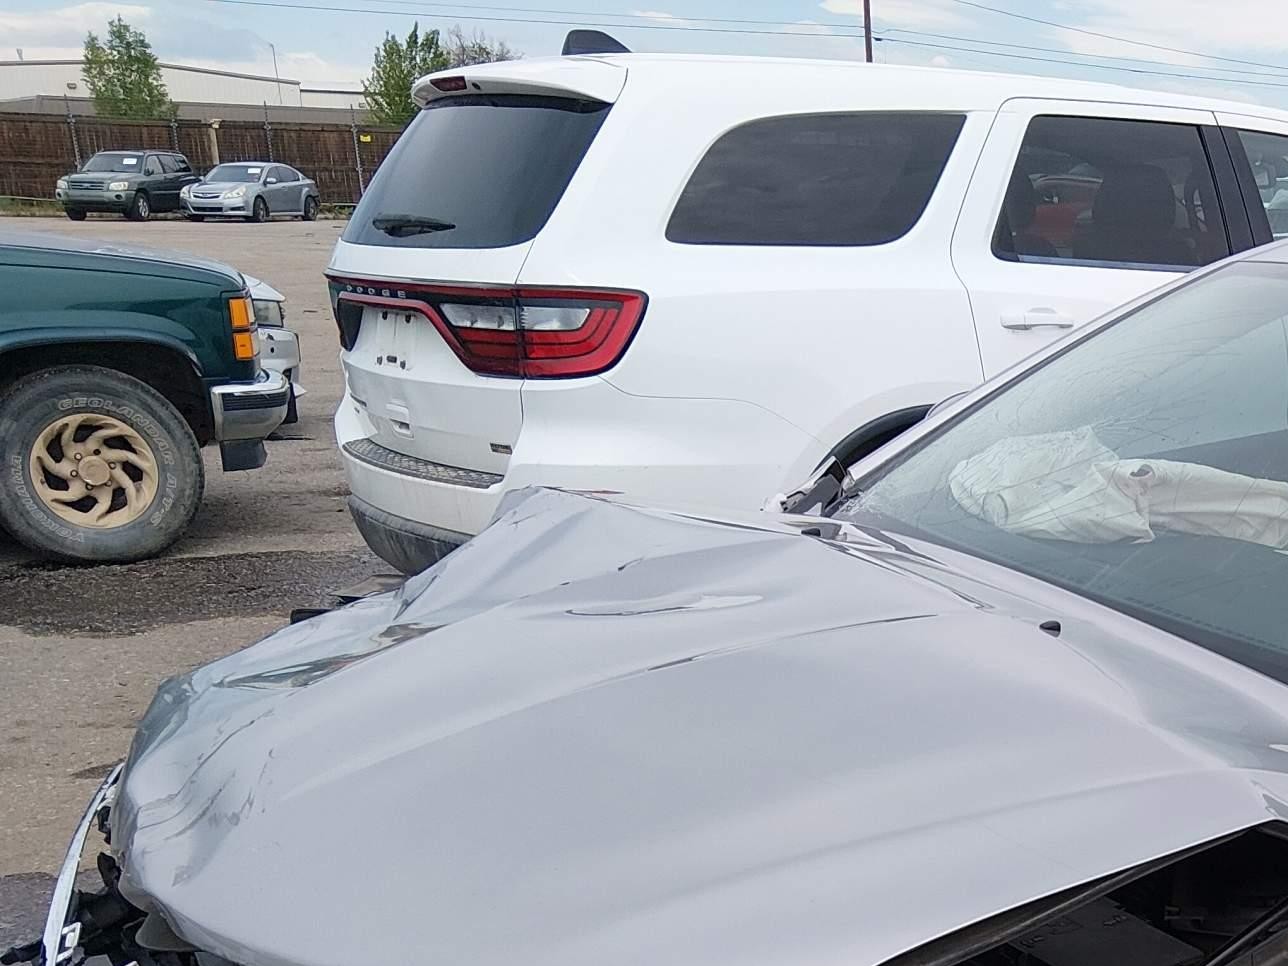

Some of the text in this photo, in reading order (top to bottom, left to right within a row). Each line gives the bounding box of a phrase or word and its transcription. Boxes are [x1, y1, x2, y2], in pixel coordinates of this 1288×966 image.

[346, 284, 406, 298] DODGE
[58, 397, 174, 464] GEOLANDAR
[11, 455, 85, 543] YOKOHAMA
